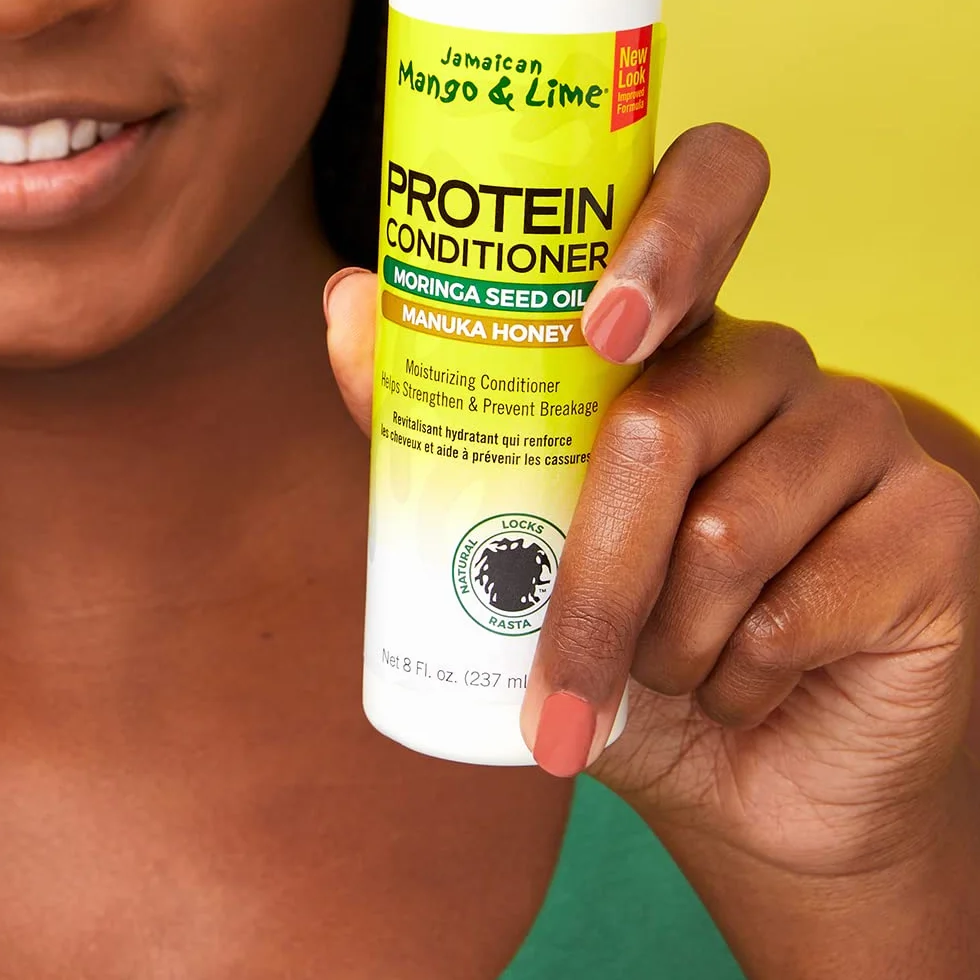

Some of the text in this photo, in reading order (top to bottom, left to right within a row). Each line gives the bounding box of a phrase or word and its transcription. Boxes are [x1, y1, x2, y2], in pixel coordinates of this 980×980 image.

[441, 46, 542, 75] Jamaican
[620, 46, 648, 68] New
[398, 60, 478, 103] Mango
[488, 76, 516, 112] &
[617, 86, 645, 102] Improved
[618, 65, 645, 89] Look
[617, 99, 644, 114] Formula
[387, 160, 614, 234] PROTEIN
[386, 218, 609, 273] CONDITIONER
[394, 266, 587, 308] MORINGA SEED OIL
[402, 304, 574, 343] MANUKA HONEY
[381, 370, 598, 417] Helps Strengthen & Prevent Breakage
[406, 358, 560, 393] Moisturizing Conditioner
[381, 423, 389, 439] les
[390, 429, 422, 452] cheveux
[424, 442, 434, 455] et
[436, 443, 459, 459] aide
[462, 448, 469, 461] à
[472, 449, 521, 466] prévenir
[524, 452, 541, 466] les
[393, 411, 572, 449] Revitalisant hydratant qui renforce
[501, 520, 545, 535] LOCKS
[458, 538, 478, 594] NATURAL
[488, 616, 532, 631] RASTA
[381, 647, 400, 670] Net
[402, 657, 412, 672] 8
[437, 669, 458, 684] oz.
[464, 670, 502, 688] (237
